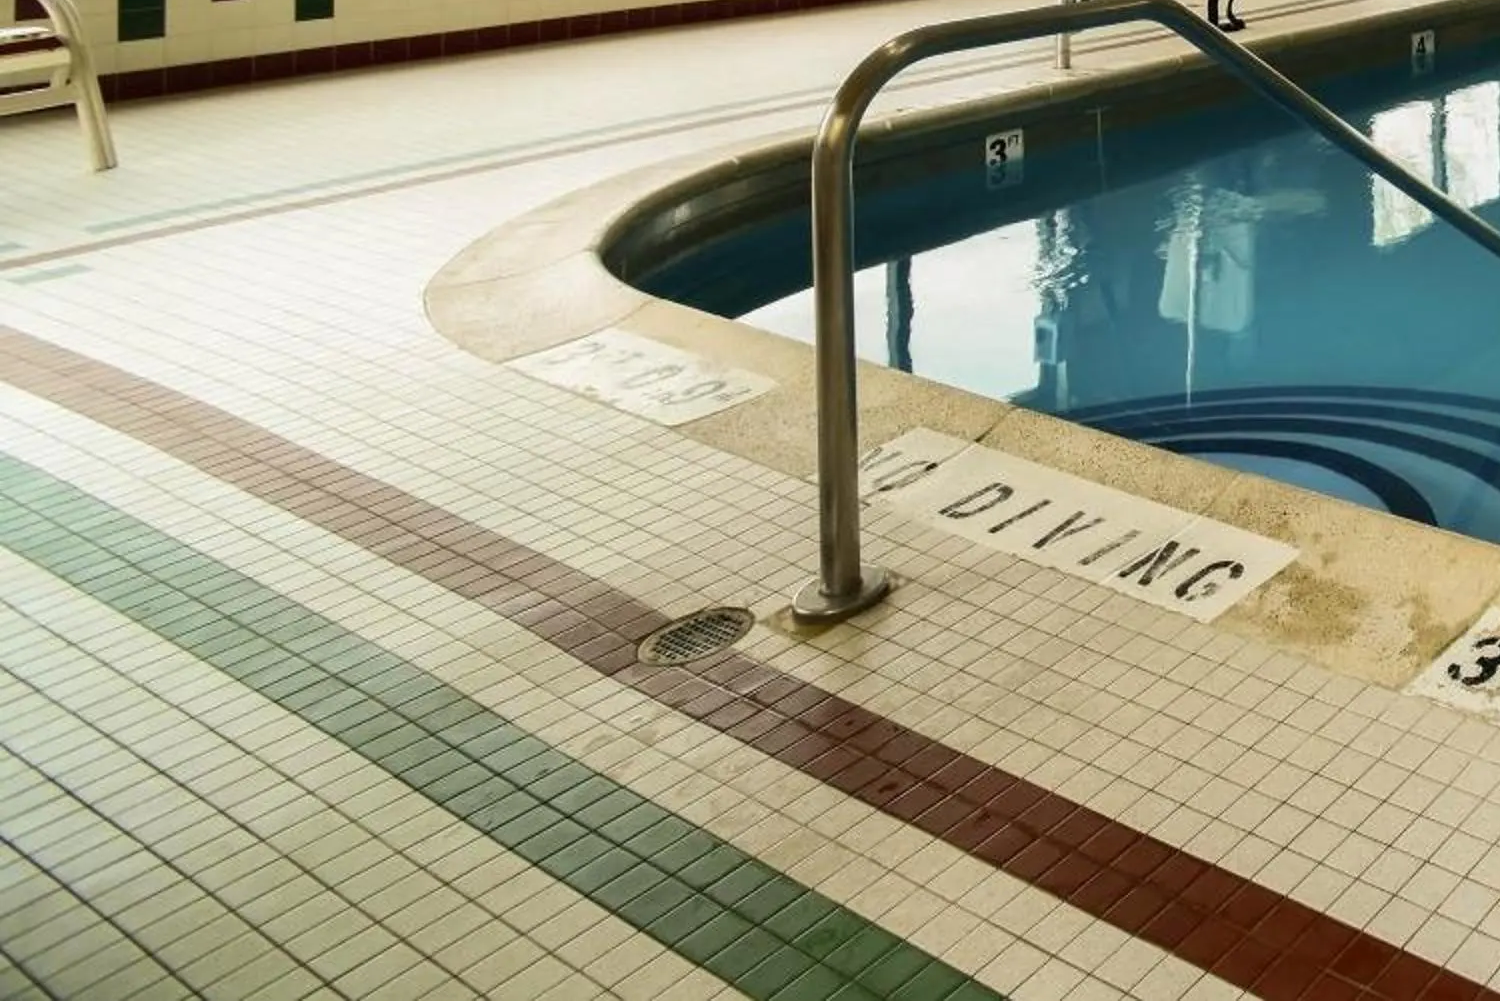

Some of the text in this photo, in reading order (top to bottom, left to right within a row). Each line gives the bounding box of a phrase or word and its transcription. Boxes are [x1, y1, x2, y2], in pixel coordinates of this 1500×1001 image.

[1416, 35, 1426, 54] 4
[990, 139, 1007, 166] 3
[938, 481, 1246, 602] DIVING
